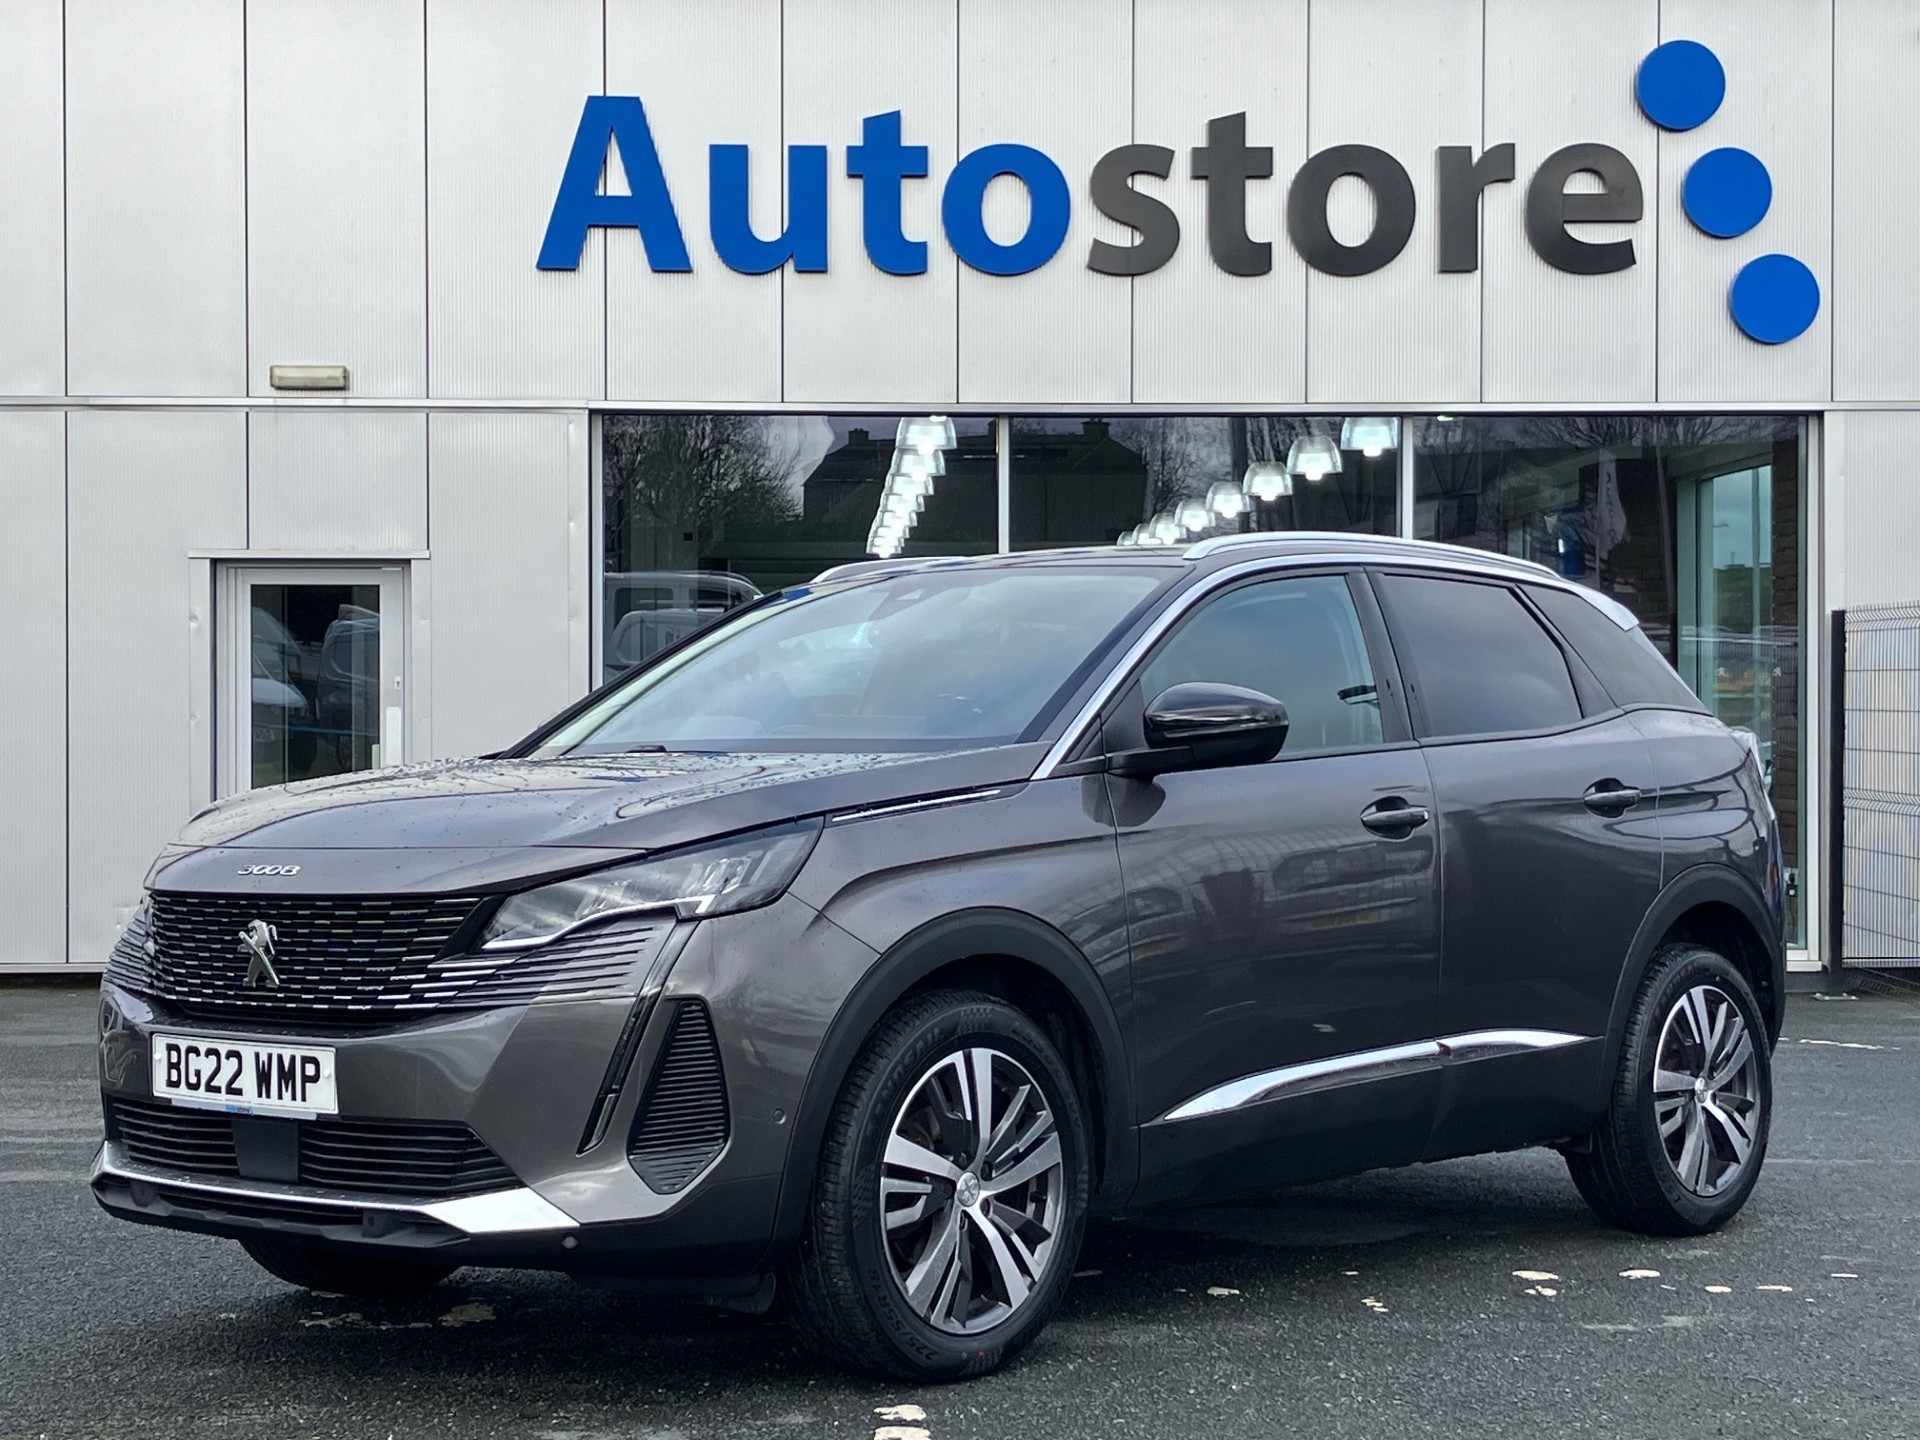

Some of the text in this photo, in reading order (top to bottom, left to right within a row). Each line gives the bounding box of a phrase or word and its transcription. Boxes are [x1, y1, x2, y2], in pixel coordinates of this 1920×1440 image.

[538, 96, 1644, 277] Autostore
[237, 864, 301, 876] 3008
[165, 1043, 321, 1102] BG22 WMP
